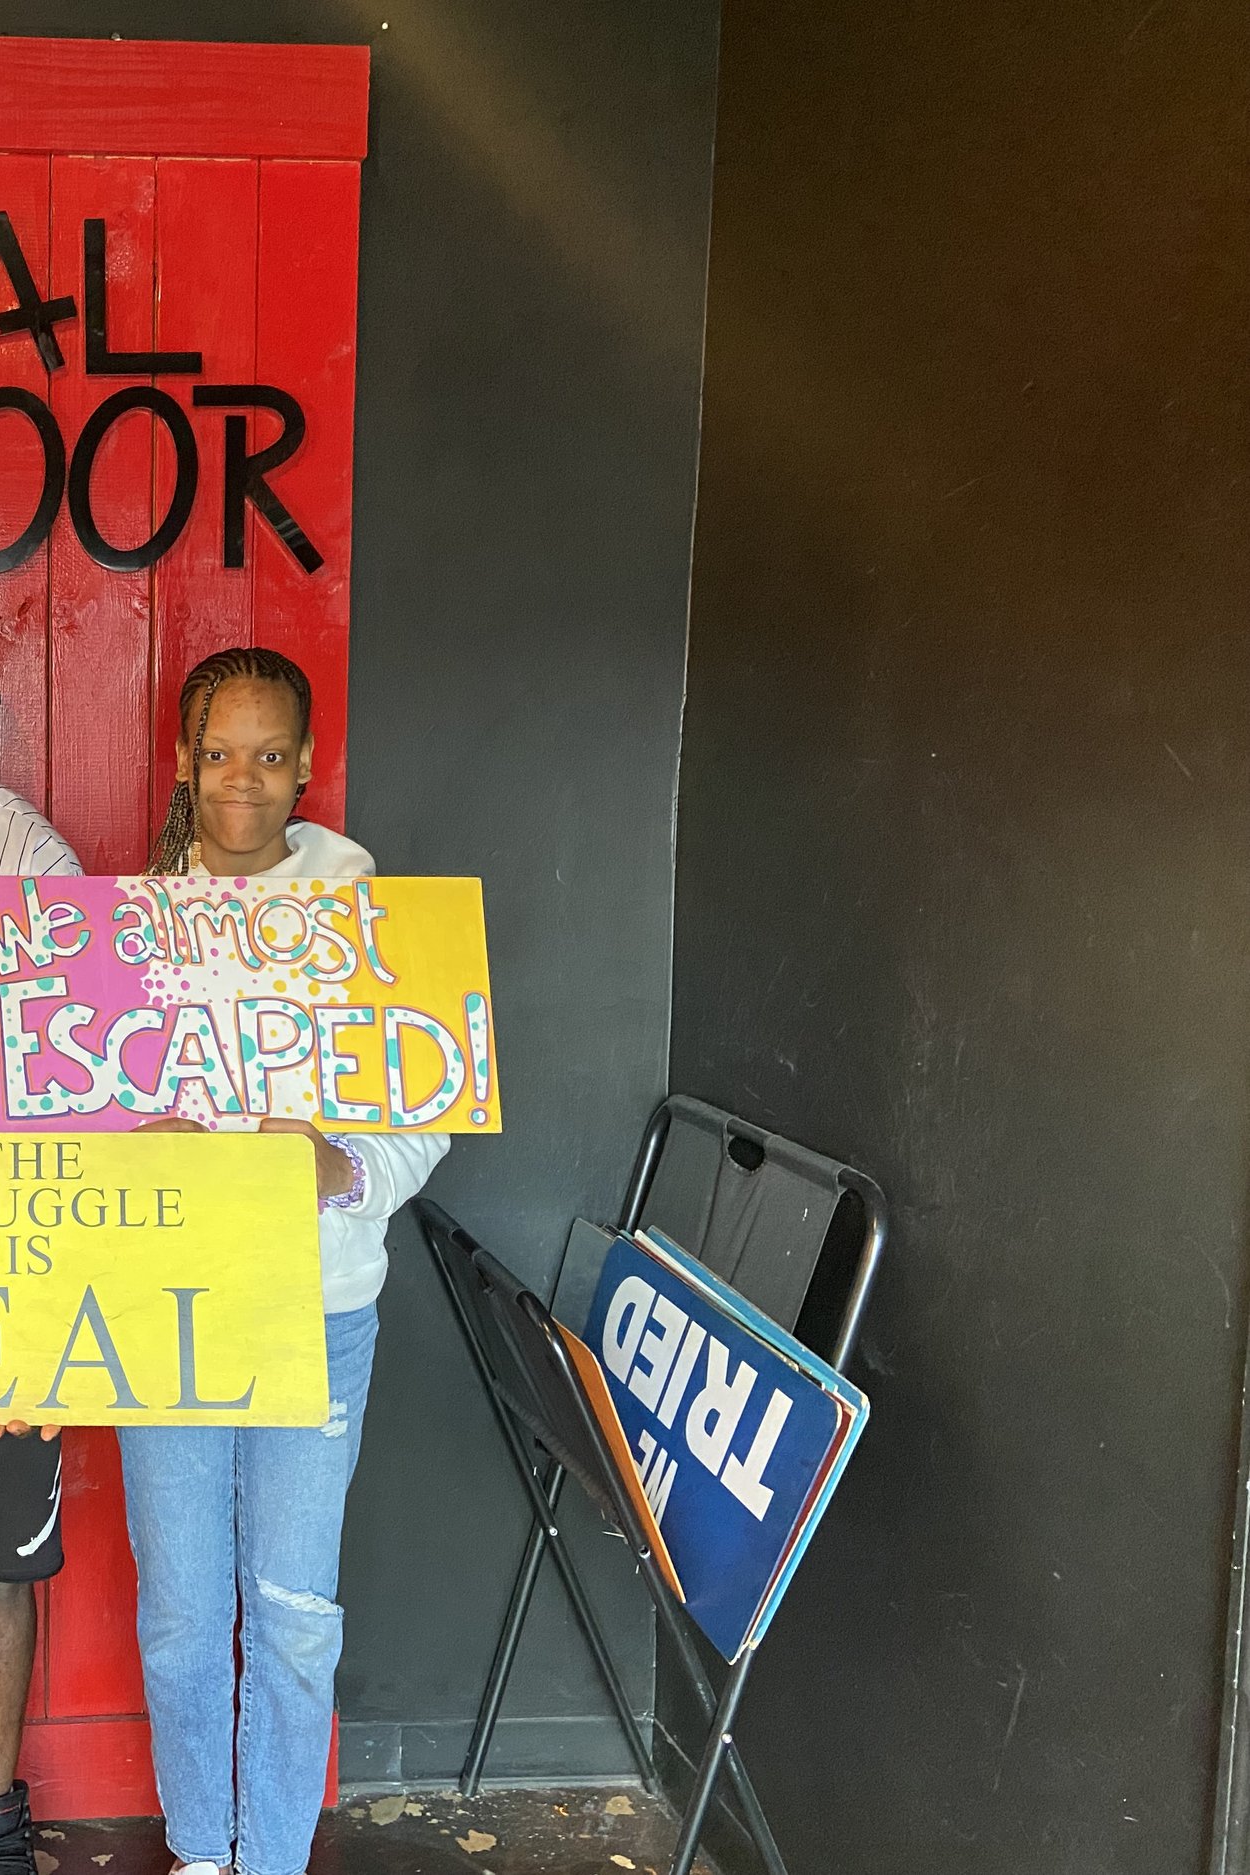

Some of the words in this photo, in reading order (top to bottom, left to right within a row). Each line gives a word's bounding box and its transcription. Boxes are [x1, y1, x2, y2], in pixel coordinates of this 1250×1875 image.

[113, 878, 398, 985] almost
[5, 1235, 53, 1275] IS
[603, 1275, 793, 1521] TRIED
